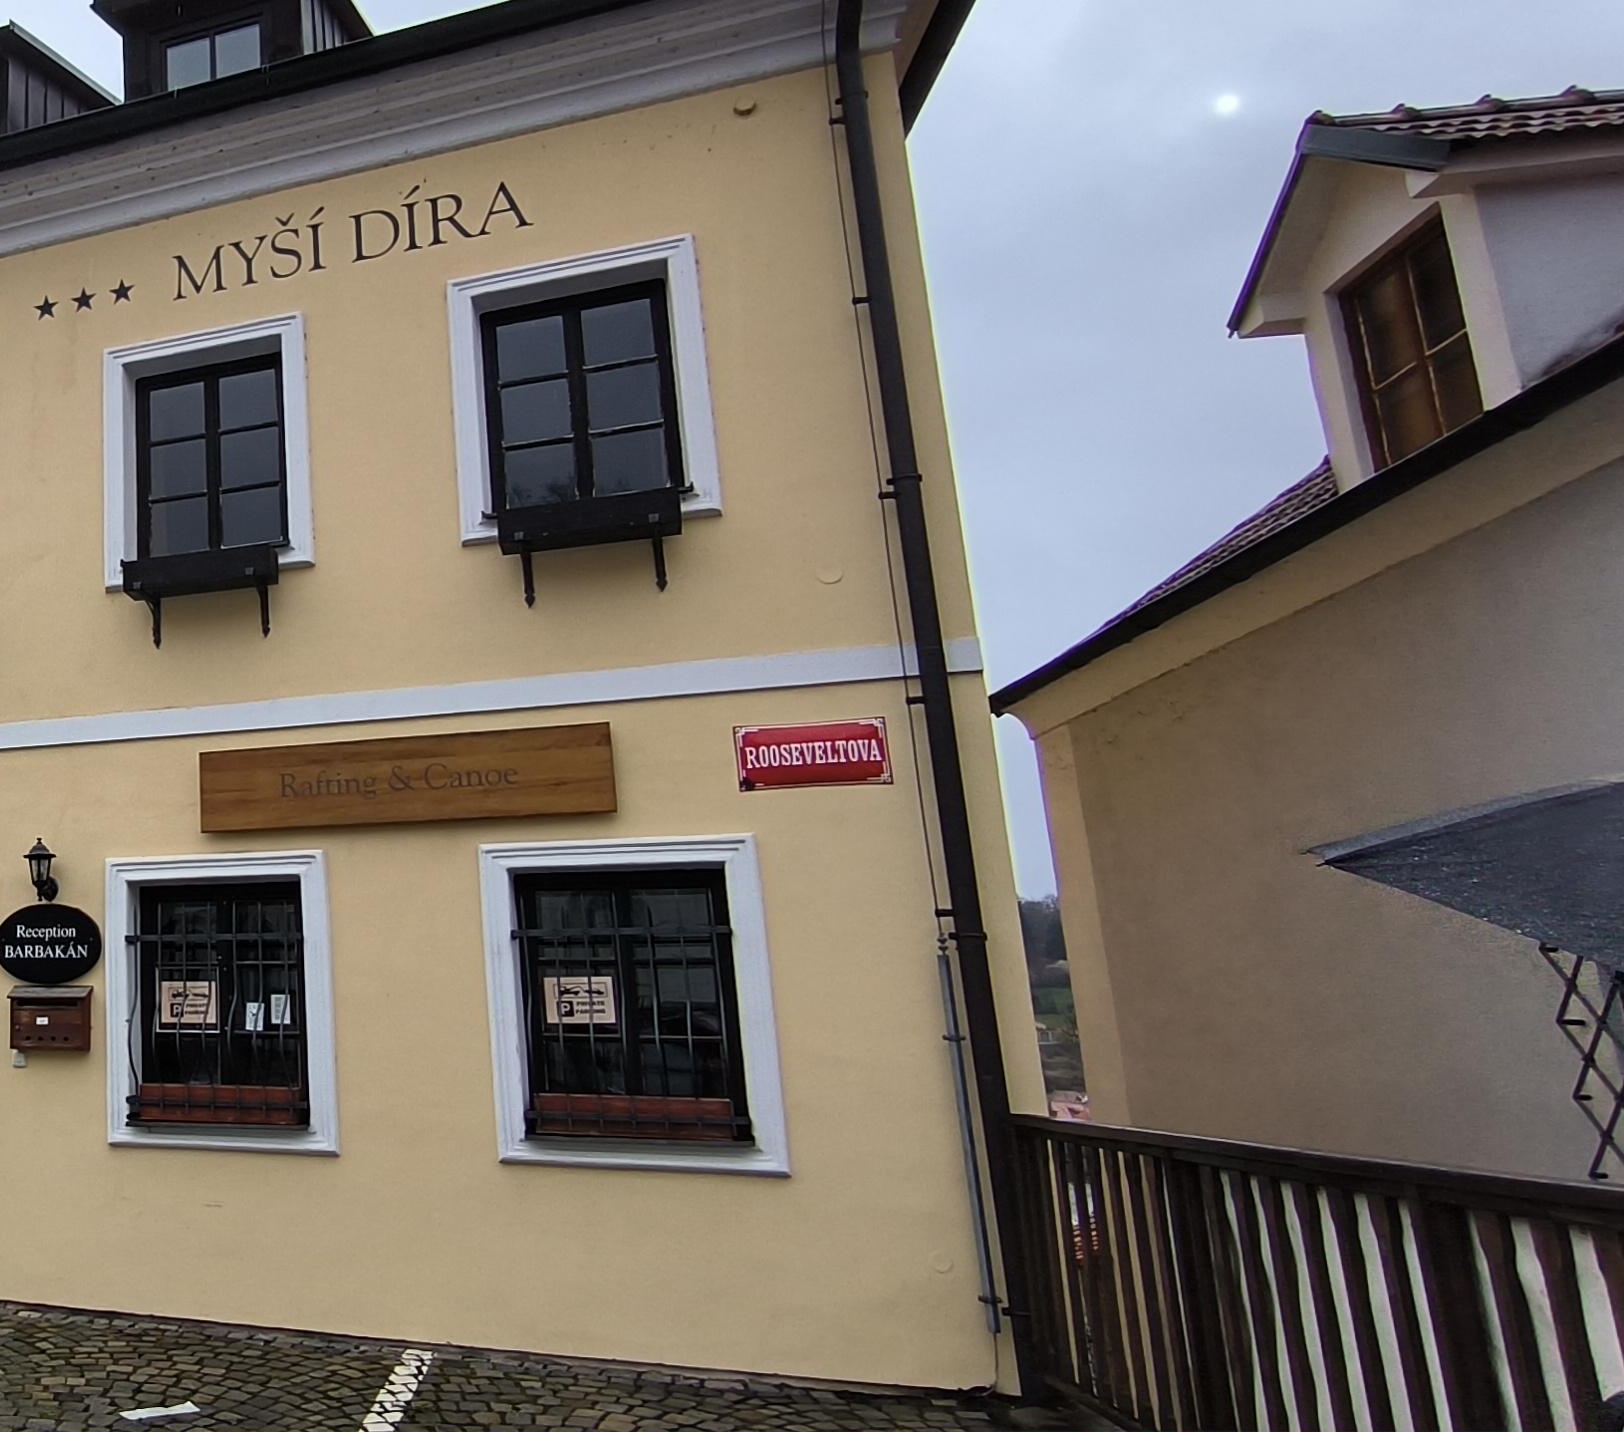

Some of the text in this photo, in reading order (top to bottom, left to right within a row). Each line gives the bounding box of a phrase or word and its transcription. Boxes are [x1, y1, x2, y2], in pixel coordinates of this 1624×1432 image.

[172, 206, 327, 301] MYŠÍ
[348, 181, 534, 264] DÍRA
[744, 739, 882, 769] ROOSEVELTOVA
[280, 763, 519, 799] Rafting & Canoe
[16, 924, 76, 942] Reception
[4, 941, 88, 959] BARBAKÁN
